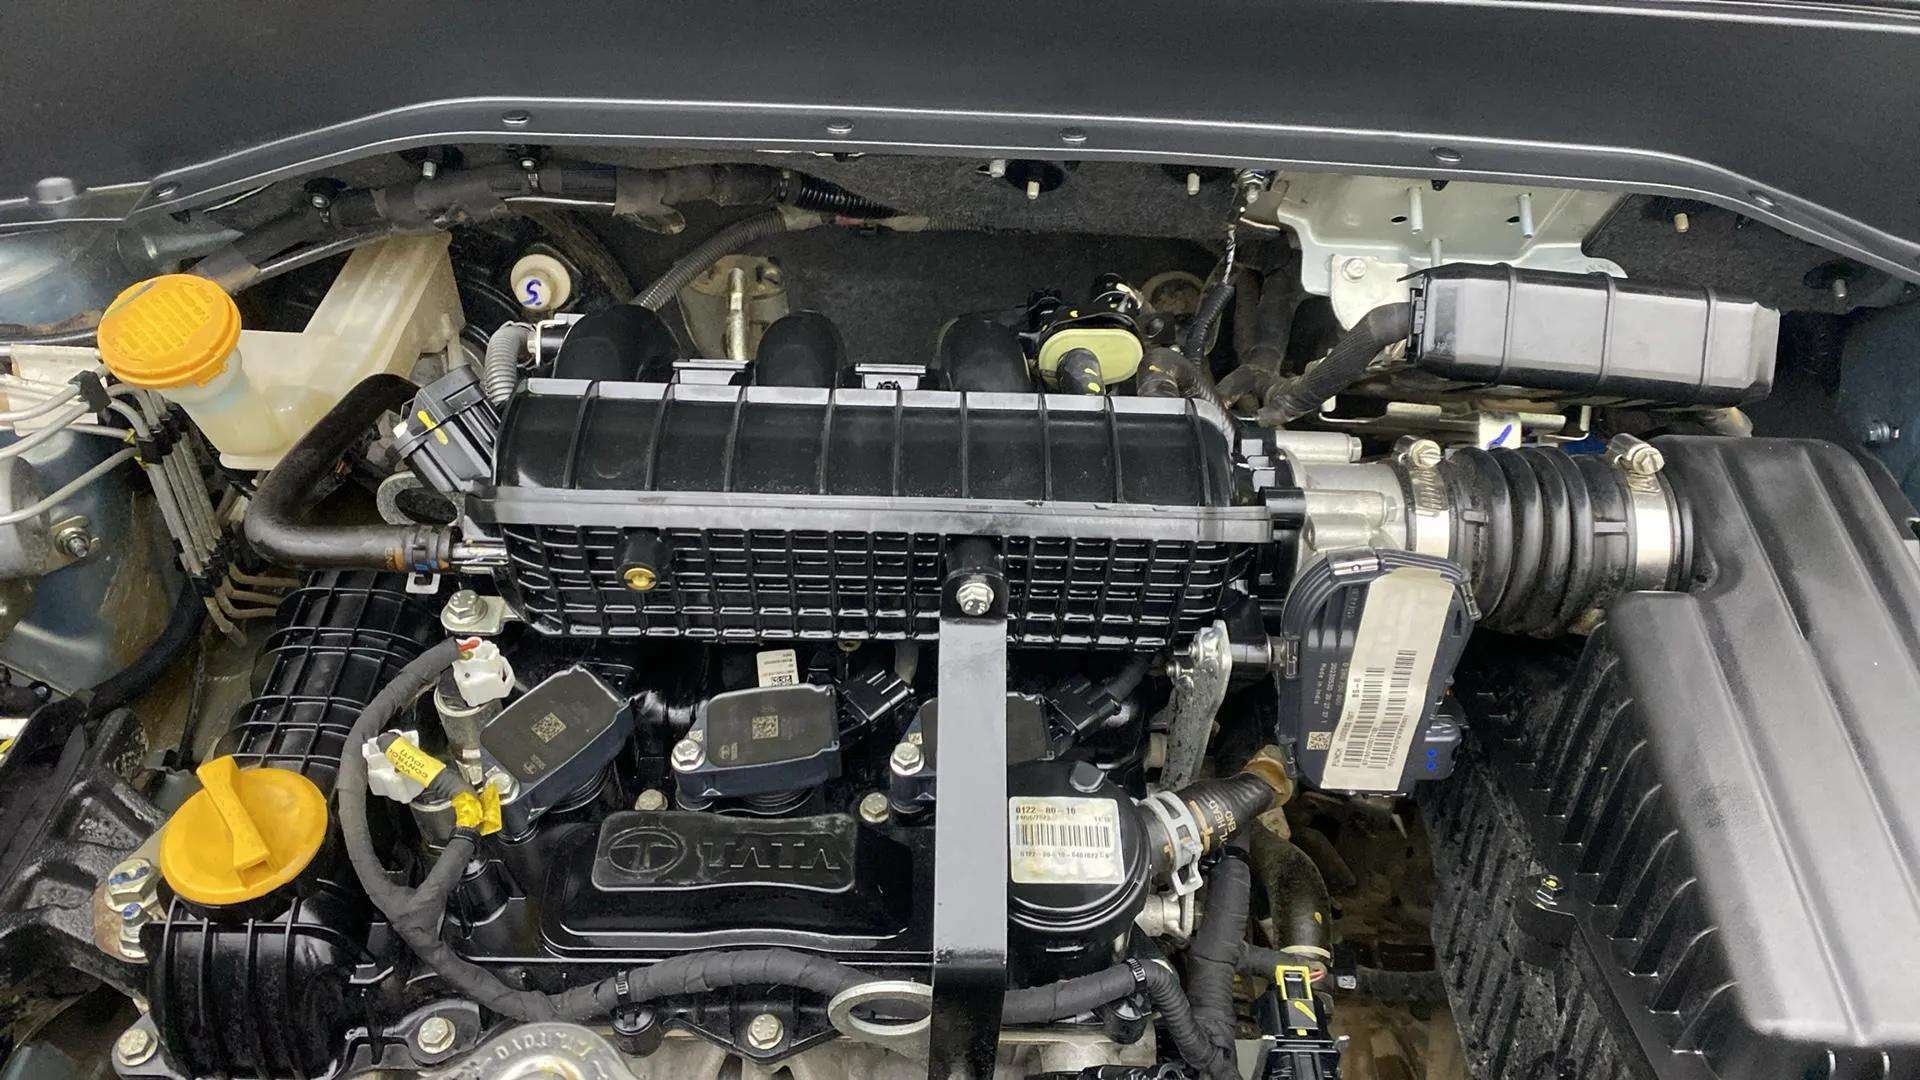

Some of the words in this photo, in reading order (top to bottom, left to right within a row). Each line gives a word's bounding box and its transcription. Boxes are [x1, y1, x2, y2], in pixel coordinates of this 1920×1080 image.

[1209, 800, 1226, 829] HEAD
[1224, 810, 1237, 833] END
[698, 836, 842, 869] TATA
